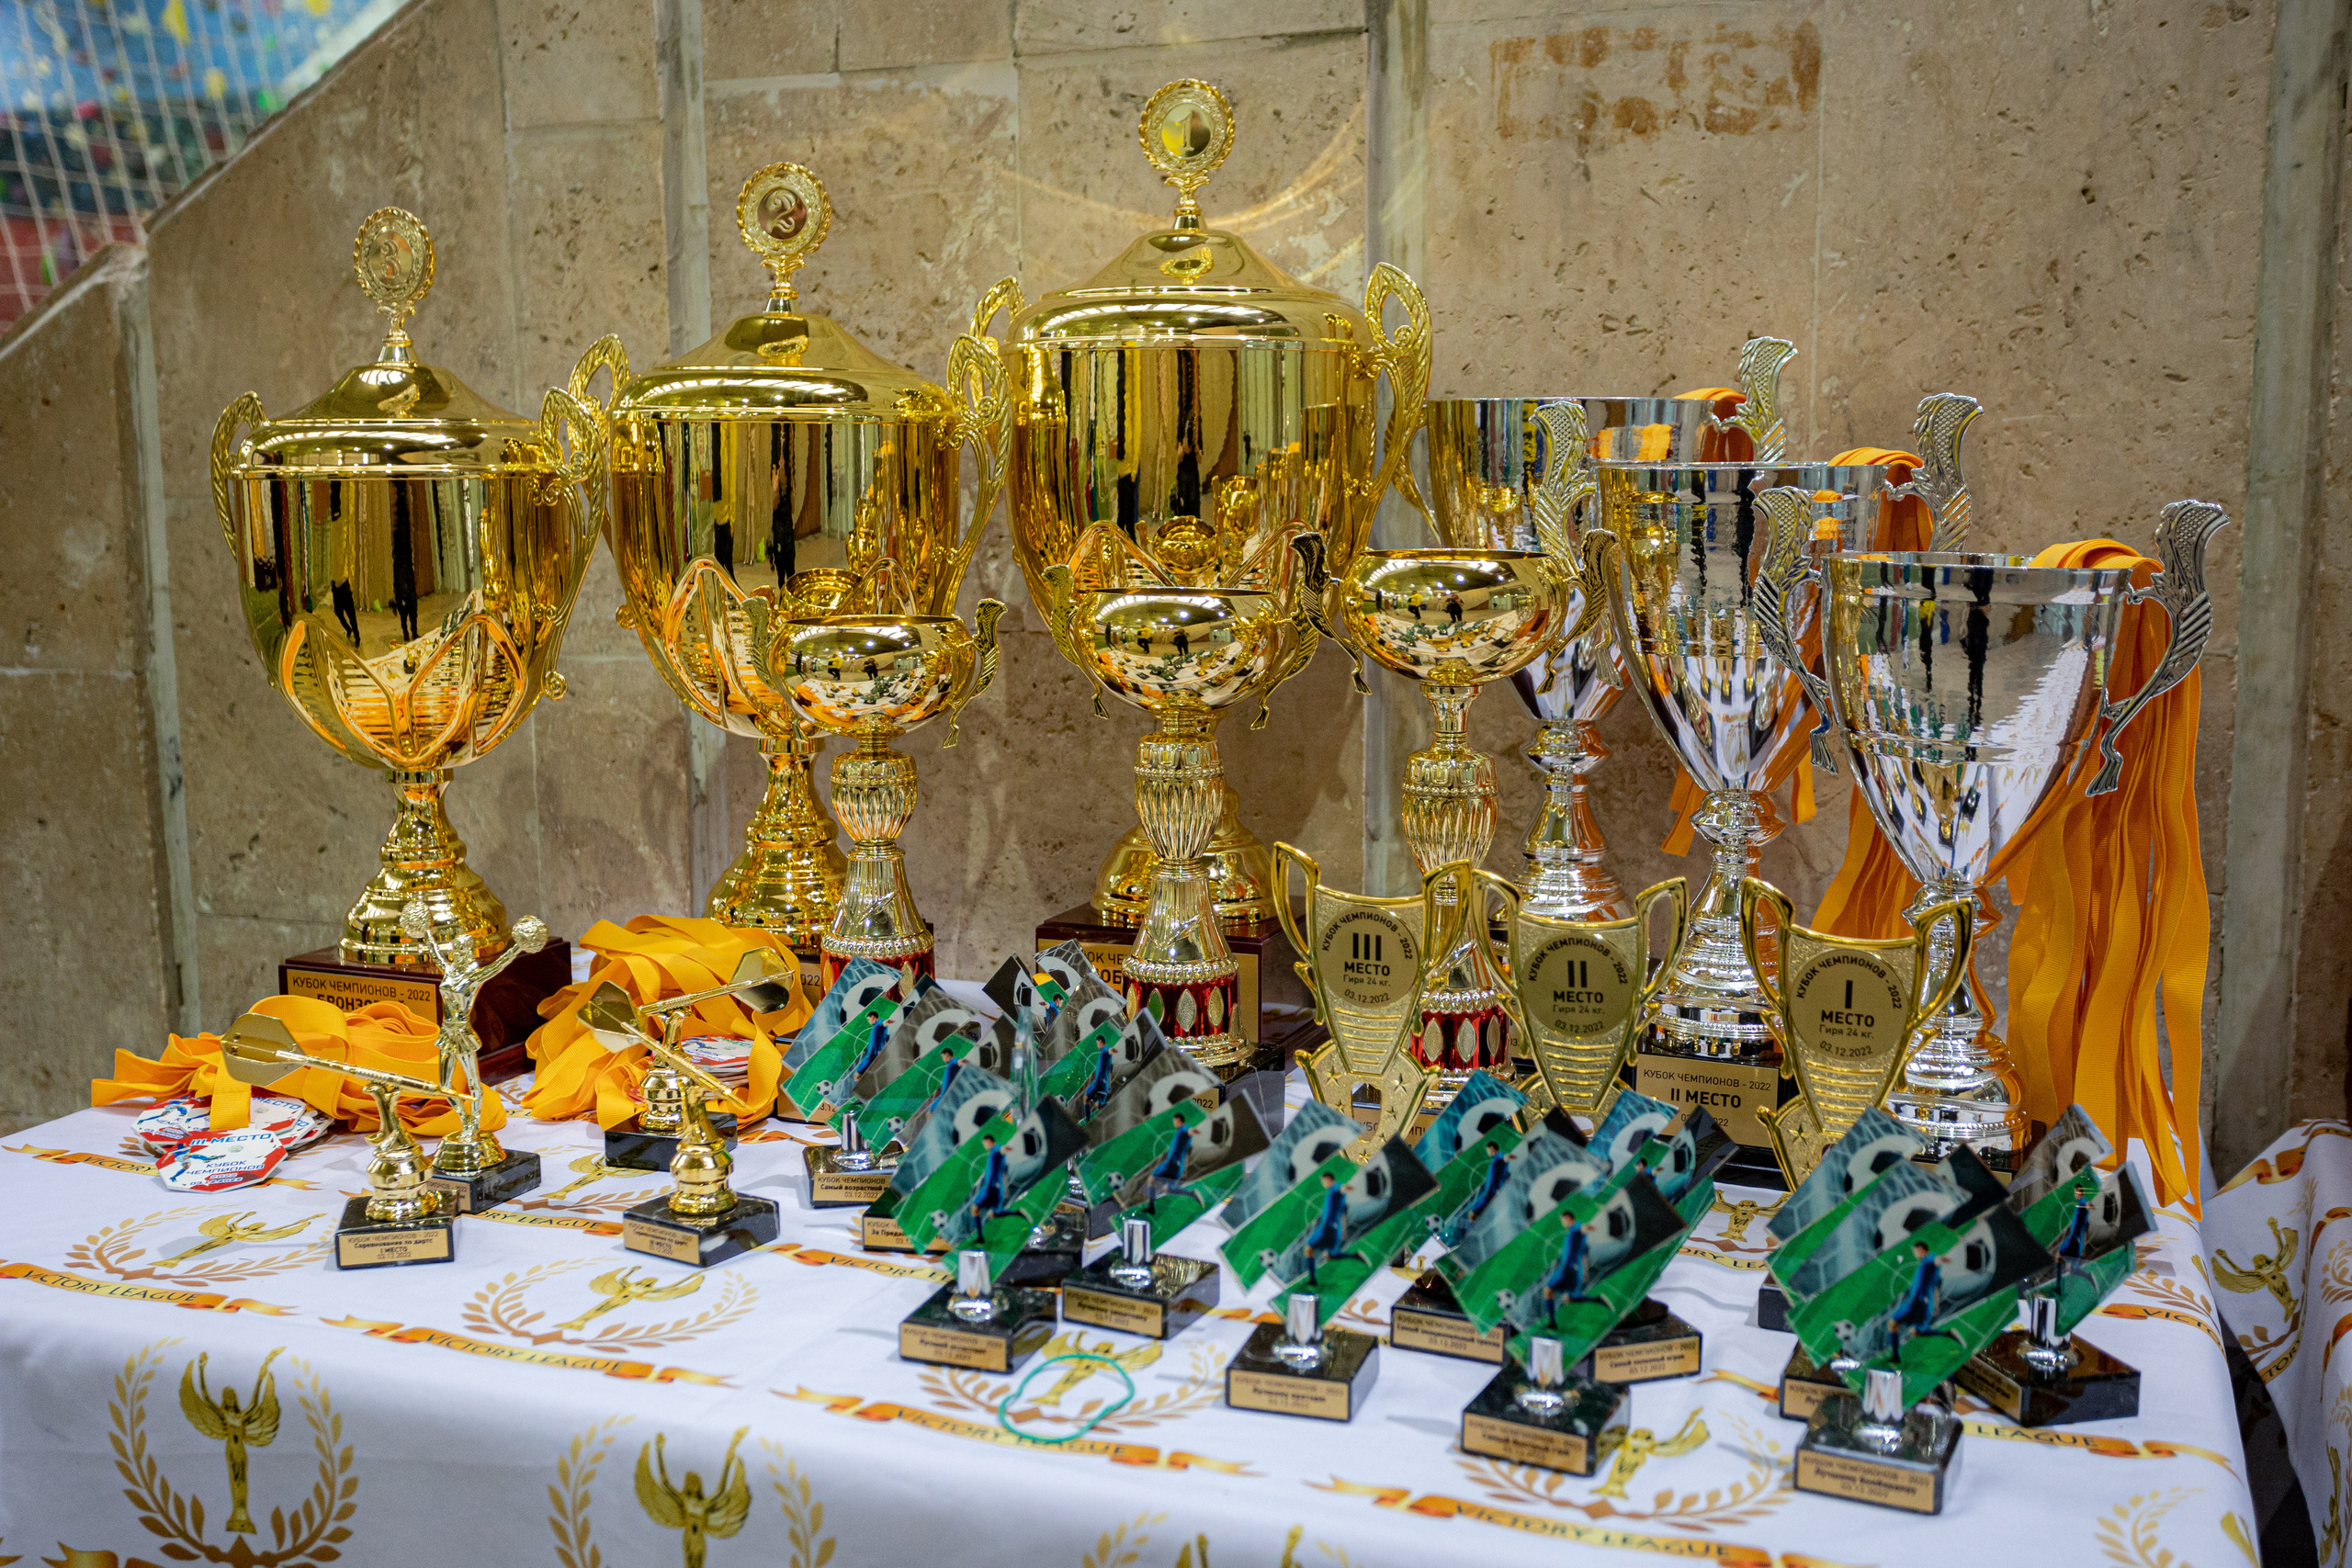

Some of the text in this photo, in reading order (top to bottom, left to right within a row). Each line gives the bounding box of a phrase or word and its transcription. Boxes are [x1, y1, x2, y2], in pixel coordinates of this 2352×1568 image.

[1322, 921, 1340, 952] КУБОК
[1340, 911, 1397, 932] ЧЕМПИОНОВ
[1400, 937, 1413, 960] 2022
[1352, 932, 1382, 961] III
[1344, 961, 1390, 976] МЕСТО
[1528, 950, 1547, 981] КУБОК
[1546, 937, 1611, 958] ЧЕМПИОНОВ
[1613, 961, 1628, 985] 2022
[800, 974, 820, 987] 022
[1343, 975, 1391, 987] Гиря 24 кг.
[1567, 960, 1588, 988] II
[1796, 965, 1819, 998] КУБОК
[1818, 955, 1887, 979] ЧЕМПИОНОВ
[1888, 985, 1903, 1010] 2022
[292, 976, 327, 990] КУБОК
[329, 980, 397, 998] ЧЕМПИОНОВ
[407, 988, 431, 1002] 2022
[1344, 988, 1390, 1004] 03.12.2022
[1554, 991, 1603, 1003] МЕСТО
[1845, 979, 1853, 1010] I
[1553, 1004, 1605, 1015] Гиря 24 кг.
[1555, 1019, 1605, 1033] 03.12.2022
[1821, 1010, 1875, 1028] МЕСТО
[1819, 1024, 1875, 1040] Гиря 24 кг.
[1820, 1040, 1872, 1057] 03.12.2022
[1644, 1069, 1676, 1080] КУБОК
[1677, 1073, 1740, 1088] ЧЕМПИОНОВ
[1749, 1080, 1771, 1091] 2022
[1670, 1088, 1741, 1109] II МЕСТО
[210, 1134, 272, 1144] МЕСТО
[84, 1156, 156, 1173] VICTORY
[187, 1164, 265, 1175] ЧЕМПИОНОВ
[206, 1160, 247, 1168] КУБОК
[517, 1215, 603, 1230] LEAGUE
[23, 1270, 202, 1302] VICTORY LEAGUE
[425, 1334, 623, 1371] VICTORY LEAGUE
[1977, 1425, 2098, 1448] LEAGUE
